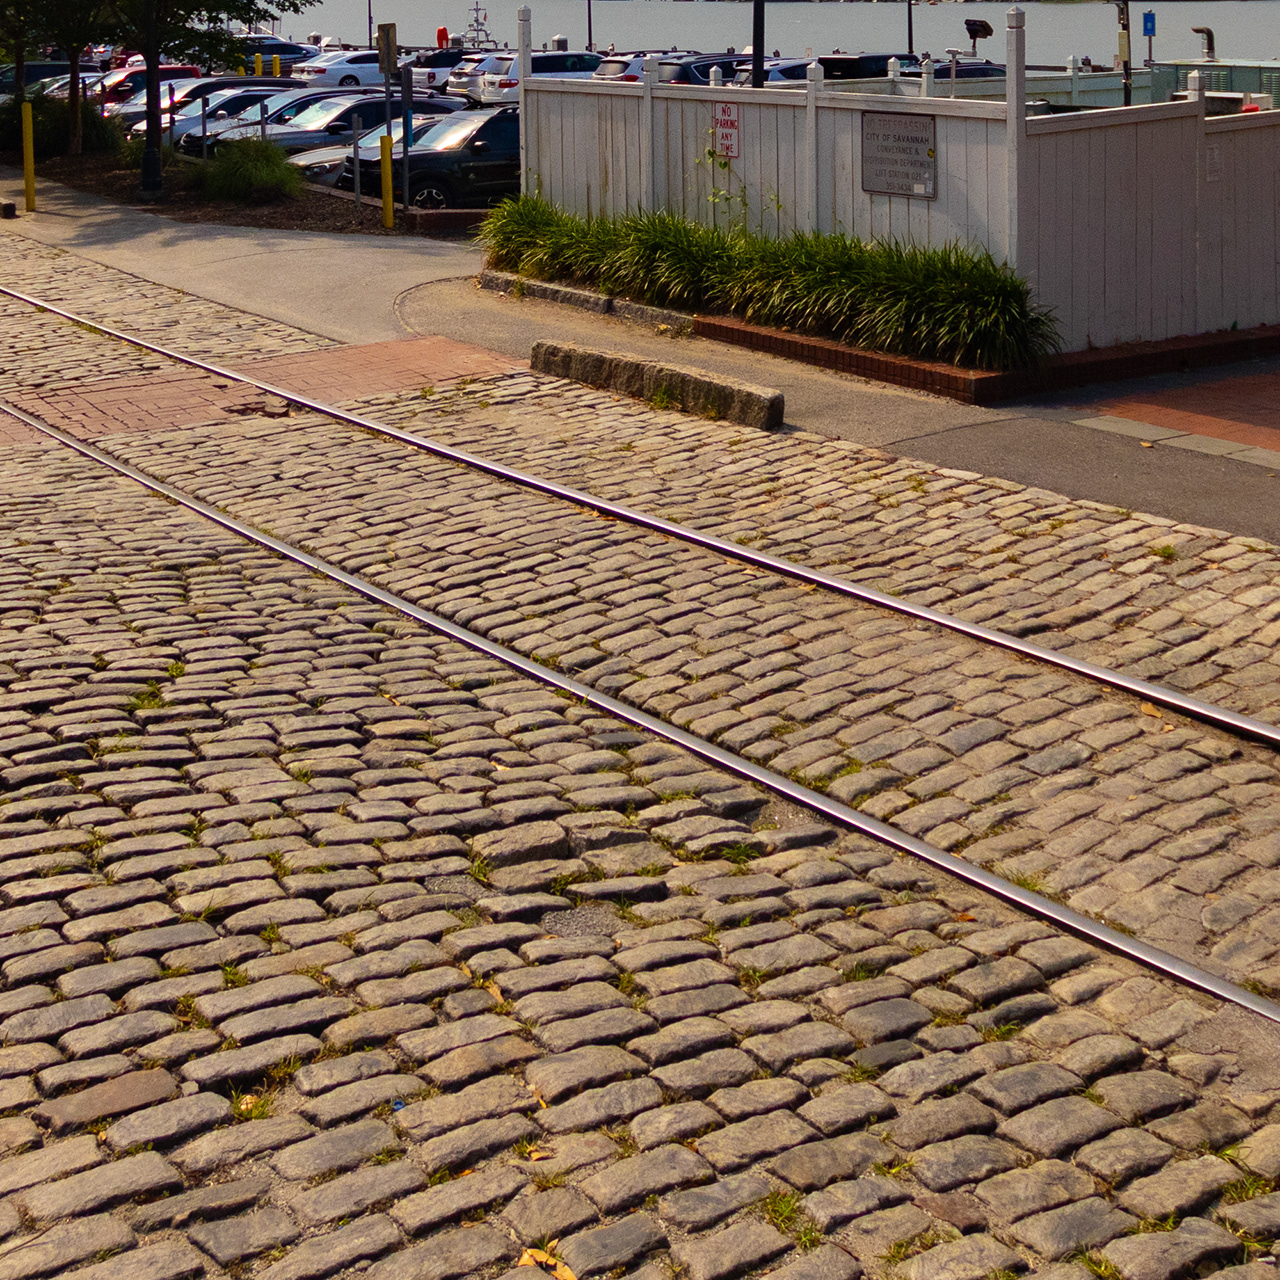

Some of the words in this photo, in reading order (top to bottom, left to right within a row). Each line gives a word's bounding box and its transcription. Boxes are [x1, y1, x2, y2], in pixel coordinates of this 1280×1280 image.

[722, 106, 732, 117] NO
[715, 118, 738, 130] PARKING
[721, 132, 733, 141] ANY
[865, 132, 880, 141] CITY
[882, 133, 892, 141] OF
[892, 134, 930, 145] SAVANNAH
[720, 143, 734, 153] TIME
[876, 144, 913, 155] CONVEYANCE
[875, 169, 887, 177] LIFT
[888, 170, 910, 180] STATION
